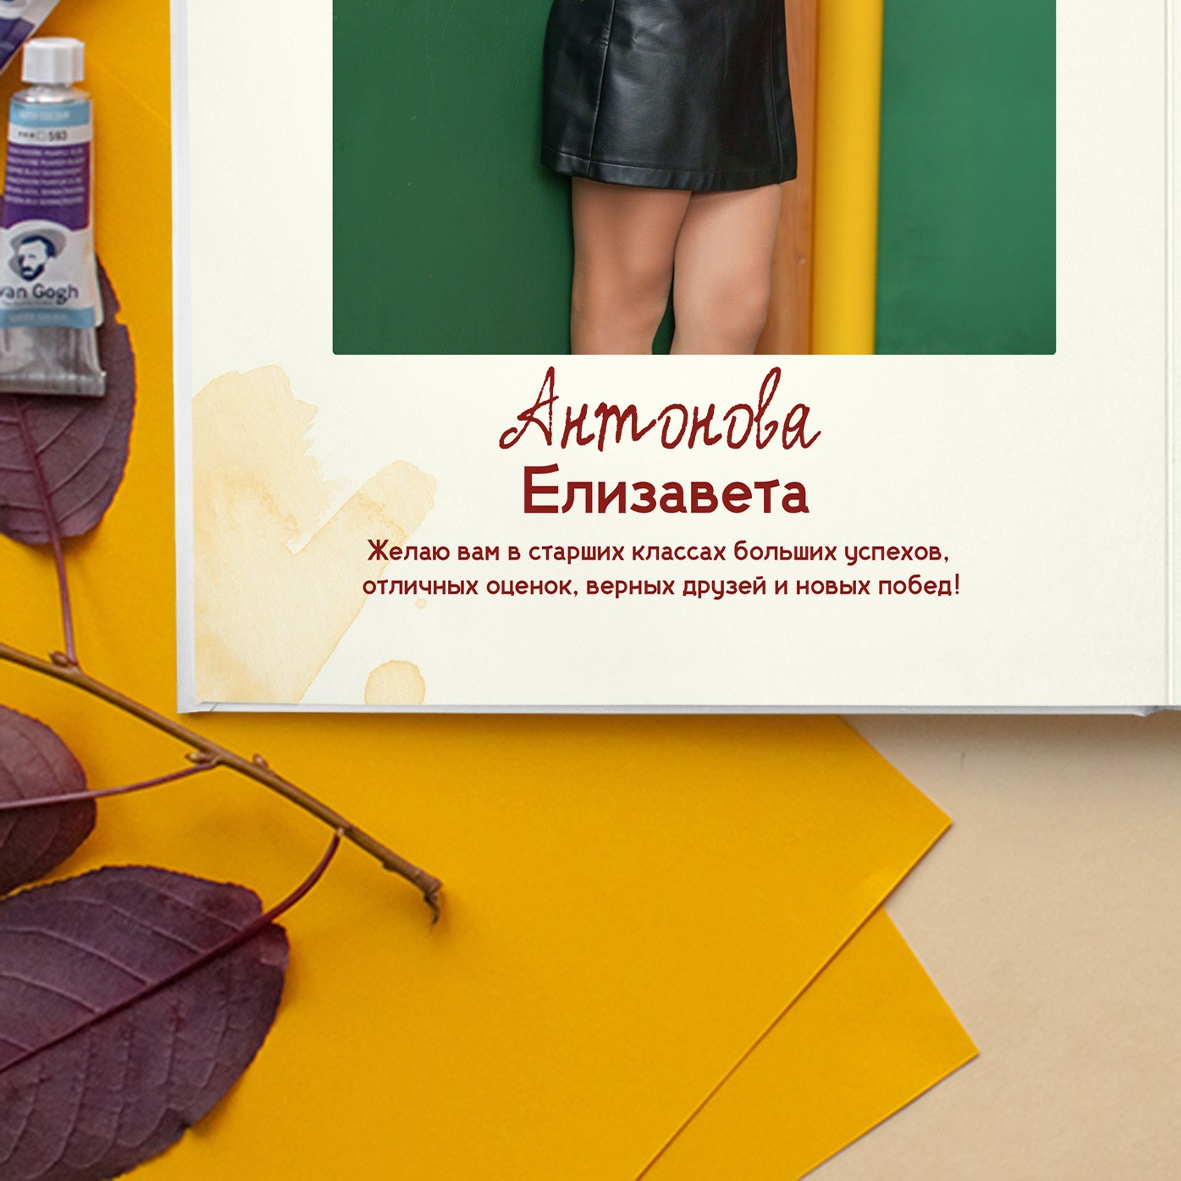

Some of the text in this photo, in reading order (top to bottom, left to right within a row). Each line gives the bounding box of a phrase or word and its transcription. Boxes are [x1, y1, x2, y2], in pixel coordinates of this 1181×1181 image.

[32, 282, 79, 305] Gogh
[499, 366, 821, 452] Антонова
[524, 463, 809, 513] Елизавета
[367, 539, 949, 566] Желаю вам в старших классах больших успехов,
[362, 573, 960, 601] отличных оценок, верных друзей и новых побед!
